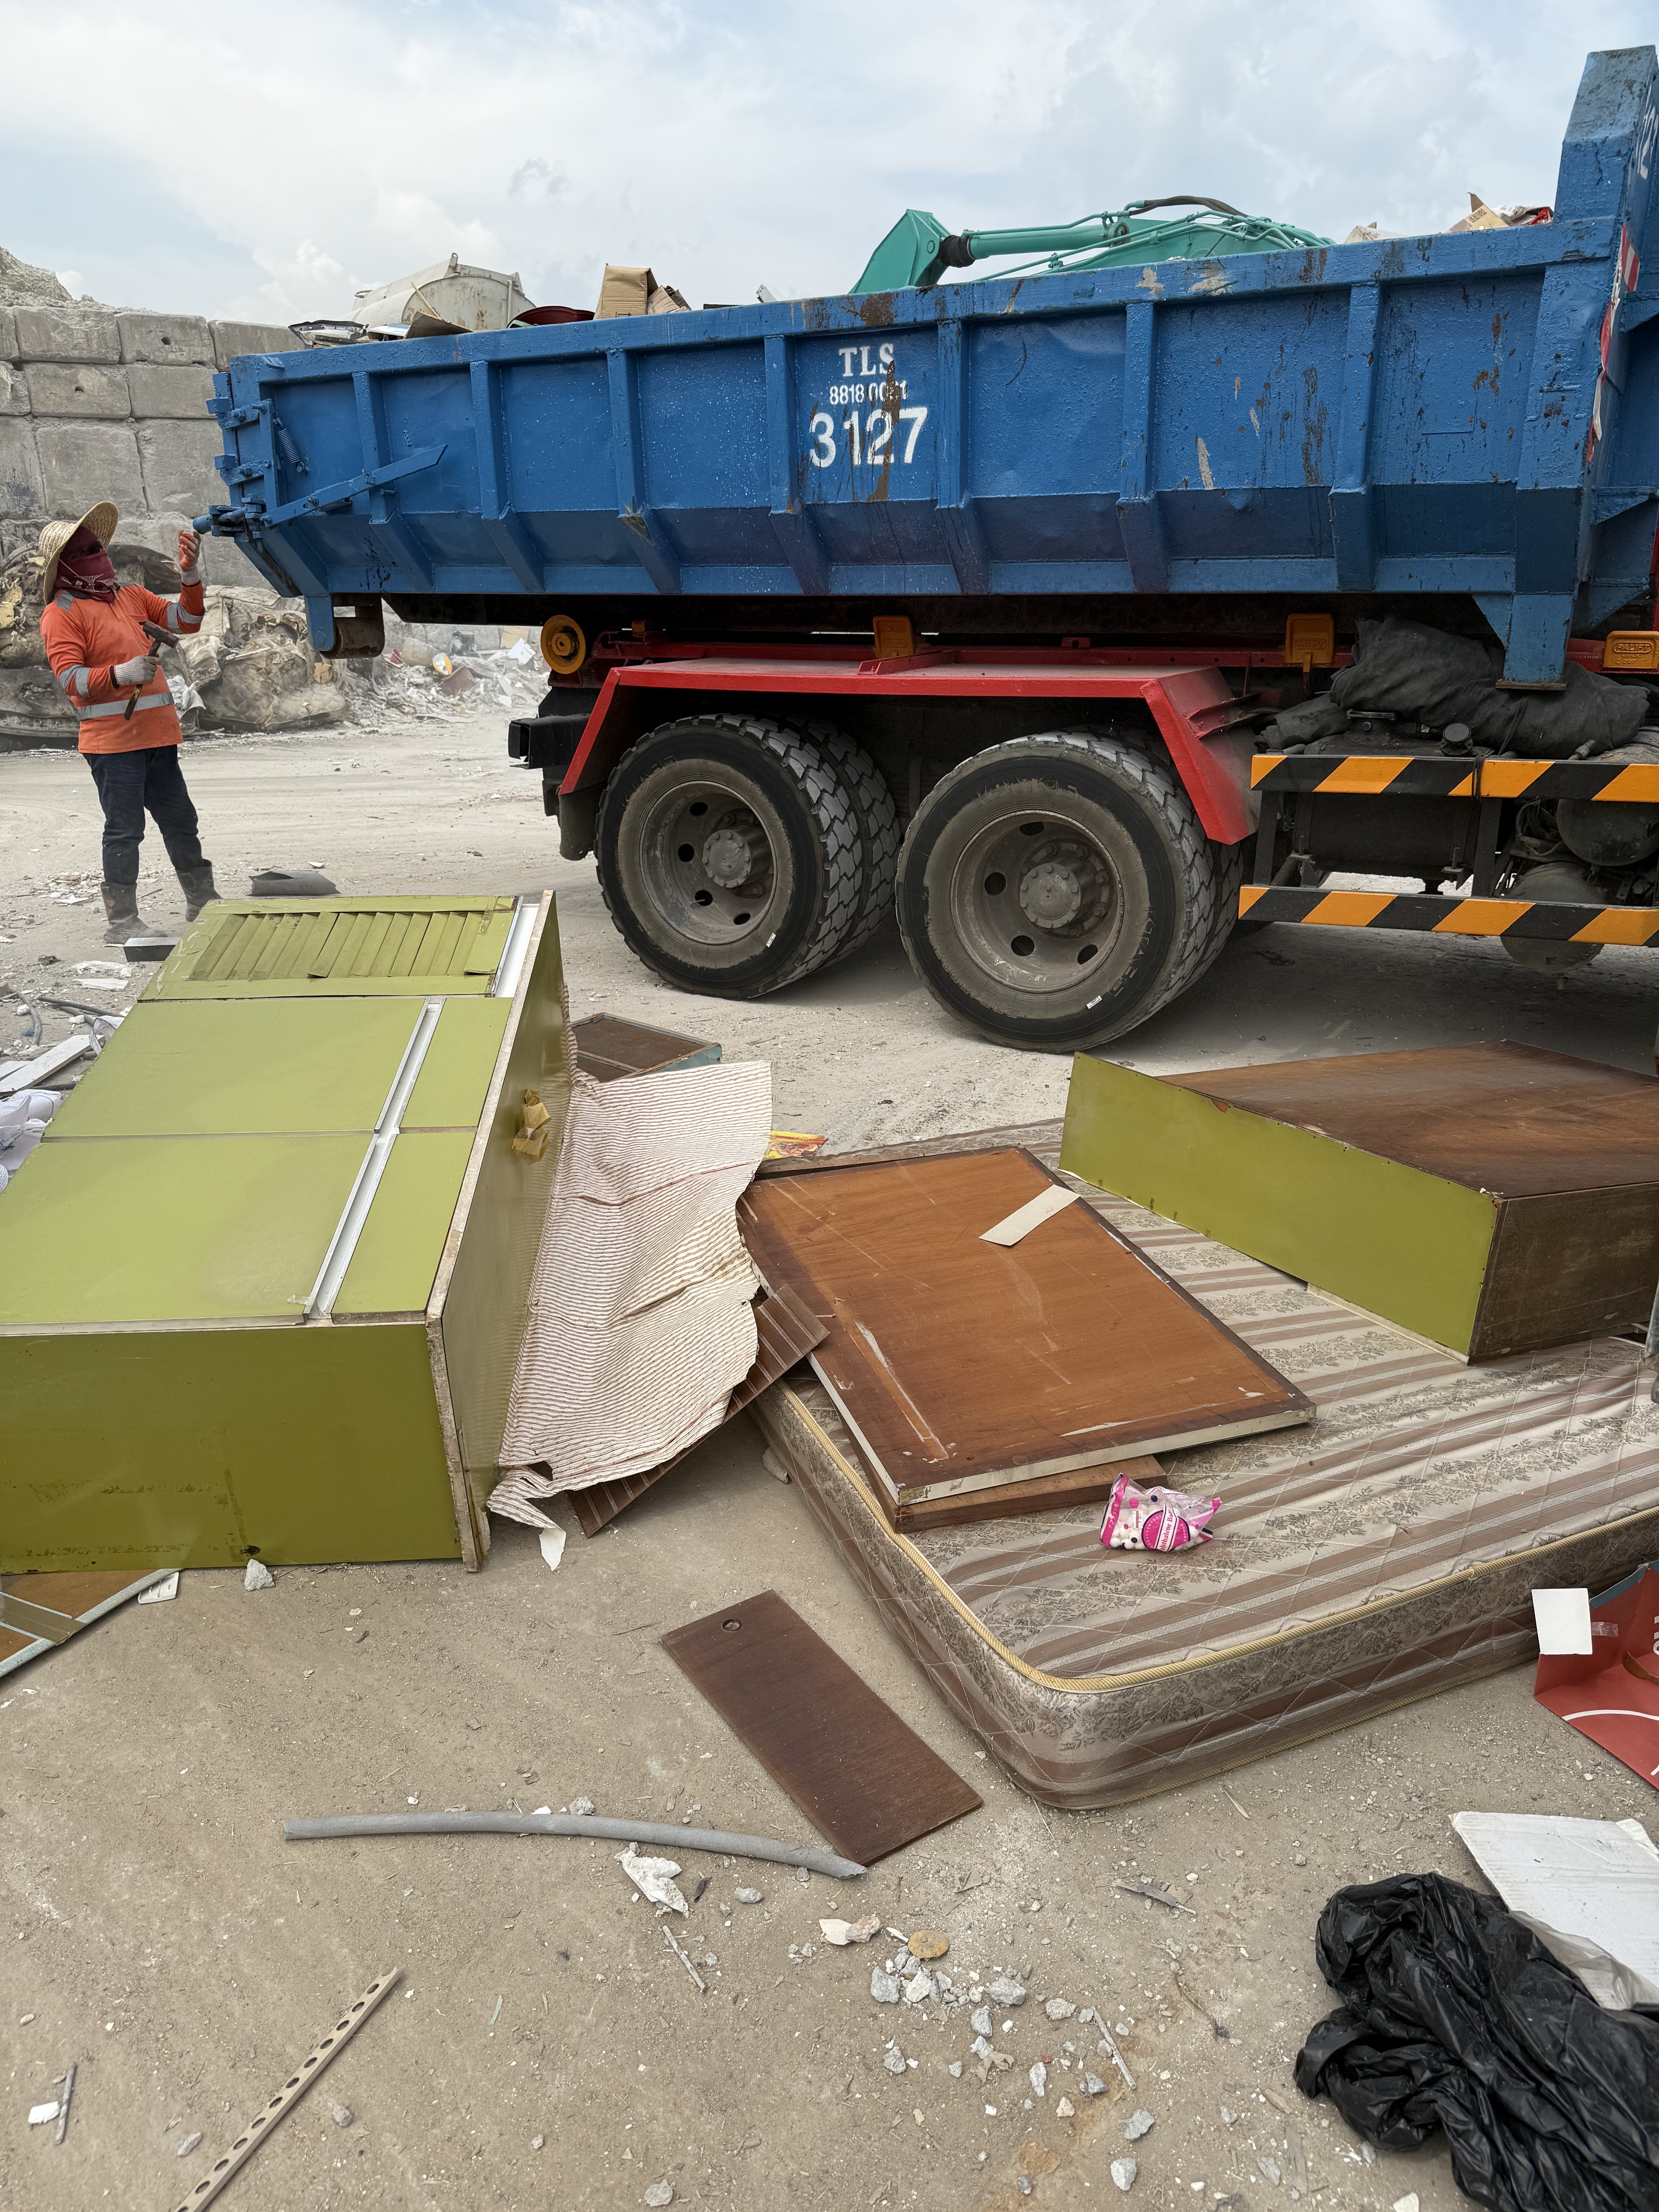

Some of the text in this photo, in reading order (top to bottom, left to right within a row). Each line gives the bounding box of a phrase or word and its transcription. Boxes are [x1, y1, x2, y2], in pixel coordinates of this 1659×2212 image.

[839, 343, 895, 377] TLS
[830, 383, 865, 405] 8818
[809, 407, 927, 468] 3127
